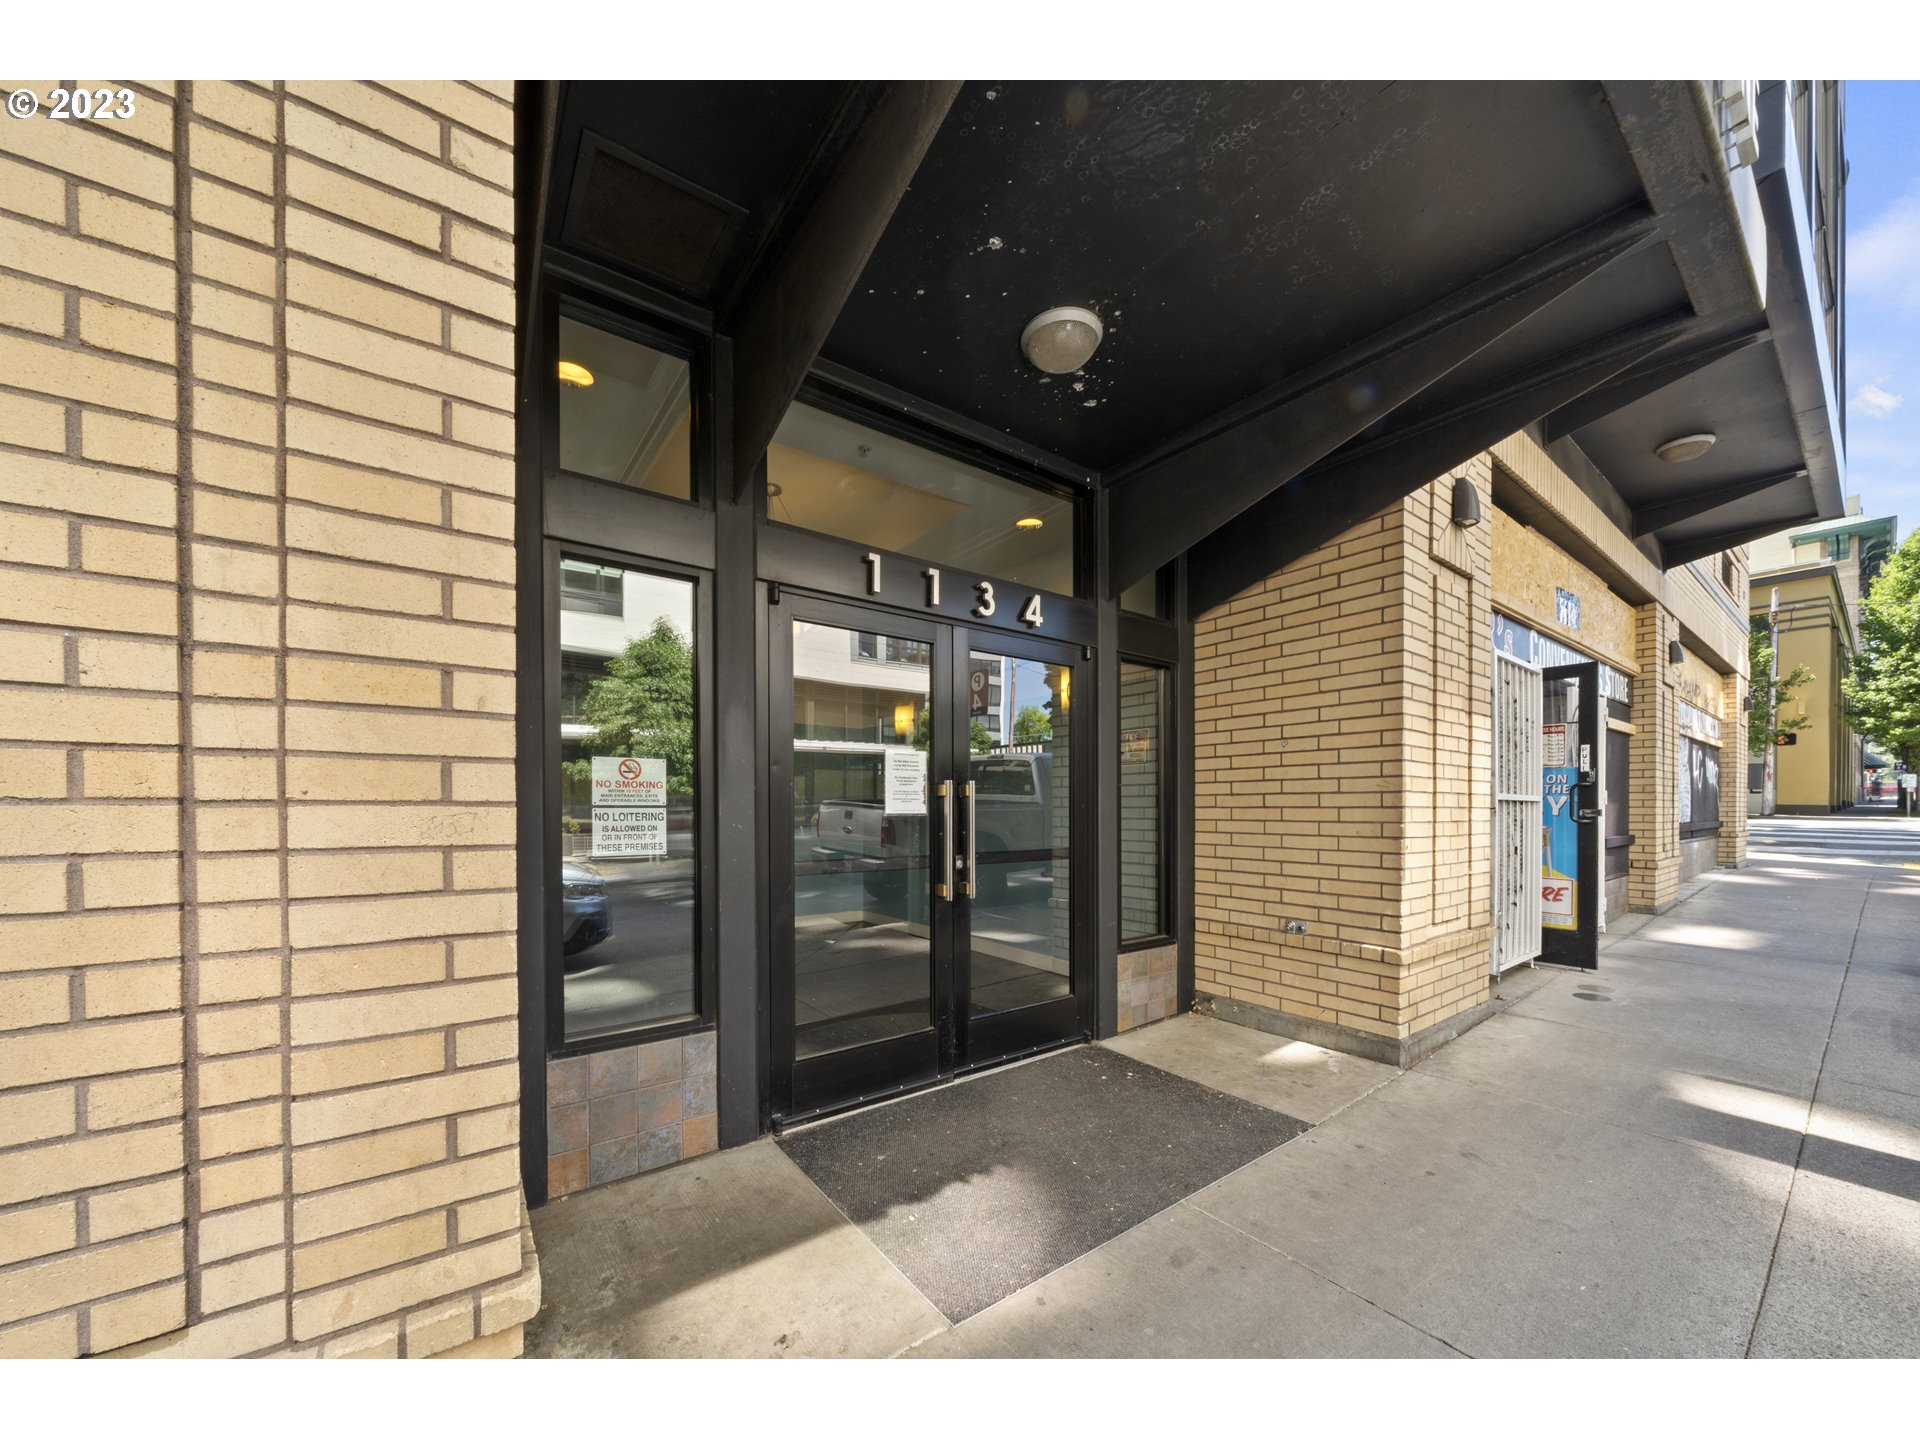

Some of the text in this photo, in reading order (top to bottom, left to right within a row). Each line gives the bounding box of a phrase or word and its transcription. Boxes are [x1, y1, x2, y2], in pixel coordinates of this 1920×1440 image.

[1605, 664, 1629, 703] STORE
[1546, 774, 1567, 784] ON
[595, 780, 664, 789] NO SMOKING
[1544, 784, 1570, 794] THE
[594, 812, 664, 822] NO LOITERING
[597, 842, 664, 852] THESE PREMISES
